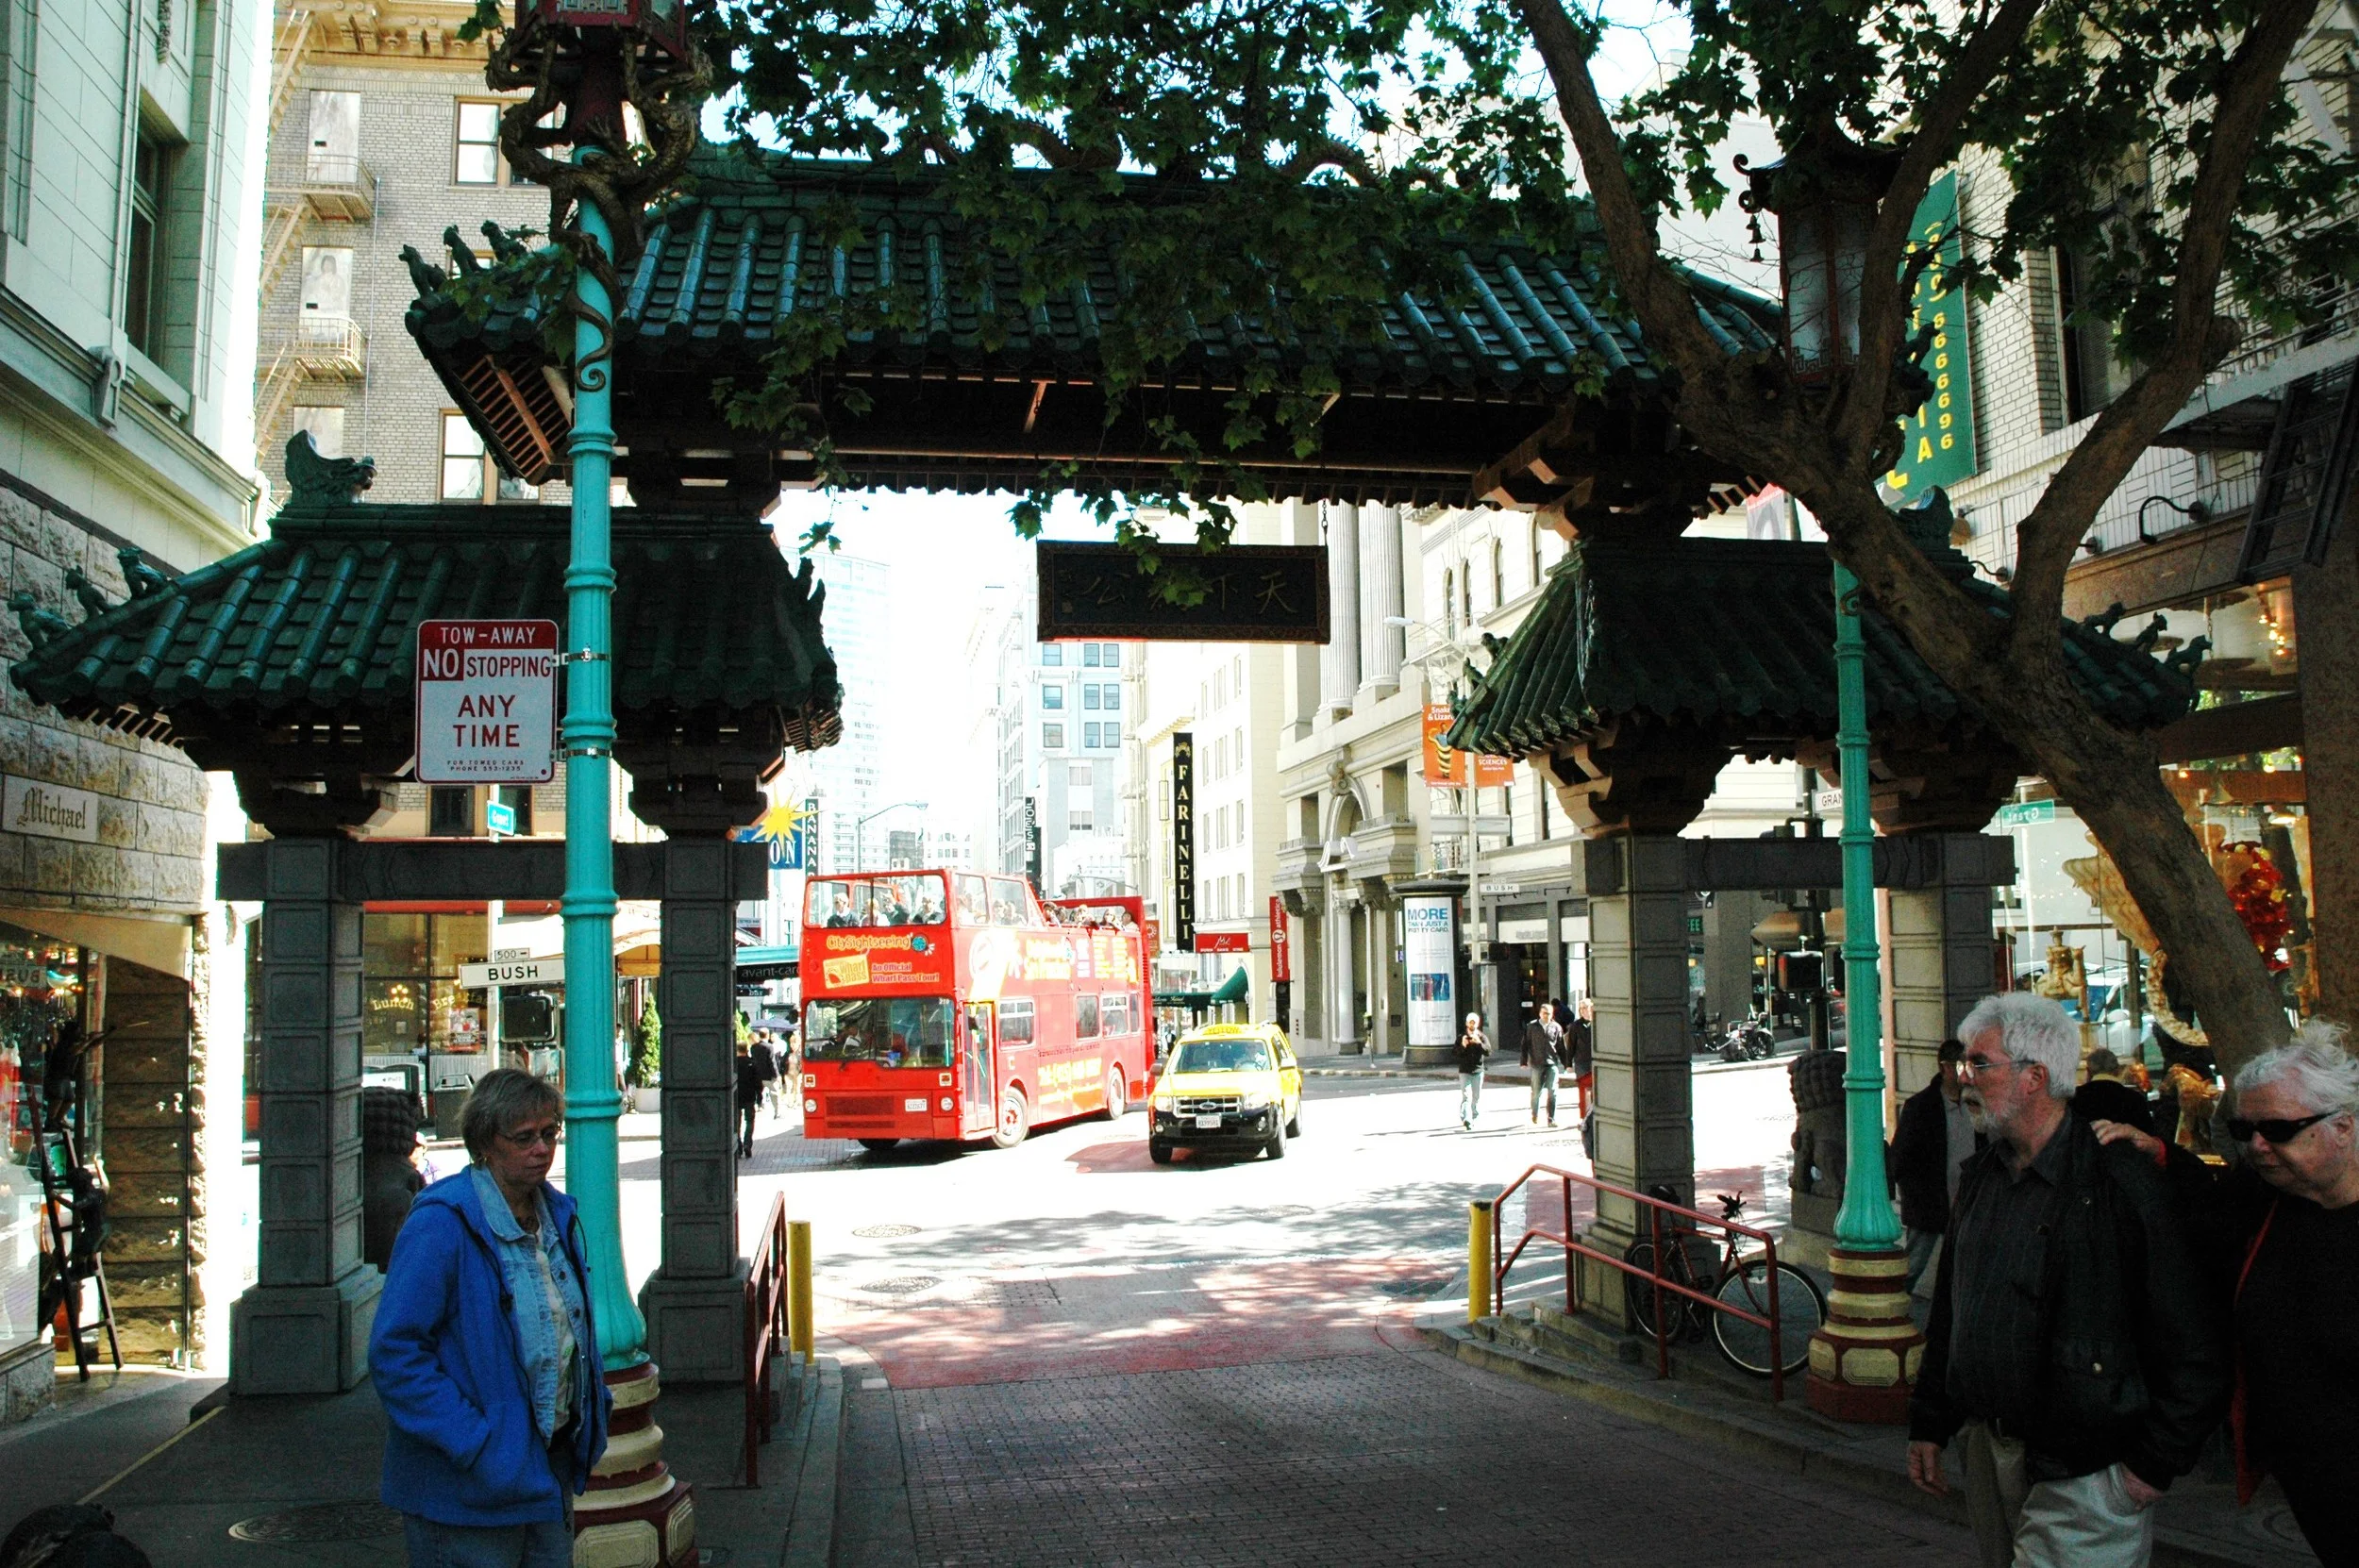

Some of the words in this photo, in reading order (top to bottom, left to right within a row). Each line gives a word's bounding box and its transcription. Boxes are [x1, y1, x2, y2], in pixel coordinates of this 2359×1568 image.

[441, 626, 536, 644] TOW-AWAY
[424, 648, 460, 678] NO
[466, 656, 551, 677] STOPPING
[458, 694, 516, 718] ANY
[453, 724, 521, 747] TIME
[1822, 792, 1842, 807] GRAN
[17, 787, 87, 833] Michael
[807, 802, 817, 866] BANANA
[1178, 764, 1191, 941] FARINELLI
[1408, 908, 1448, 920] MORE
[827, 934, 911, 951] CitySightseeing
[497, 950, 516, 959] 500
[488, 965, 539, 981] BUSH
[897, 974, 916, 982] Pass
[372, 996, 415, 1011] Lunch
